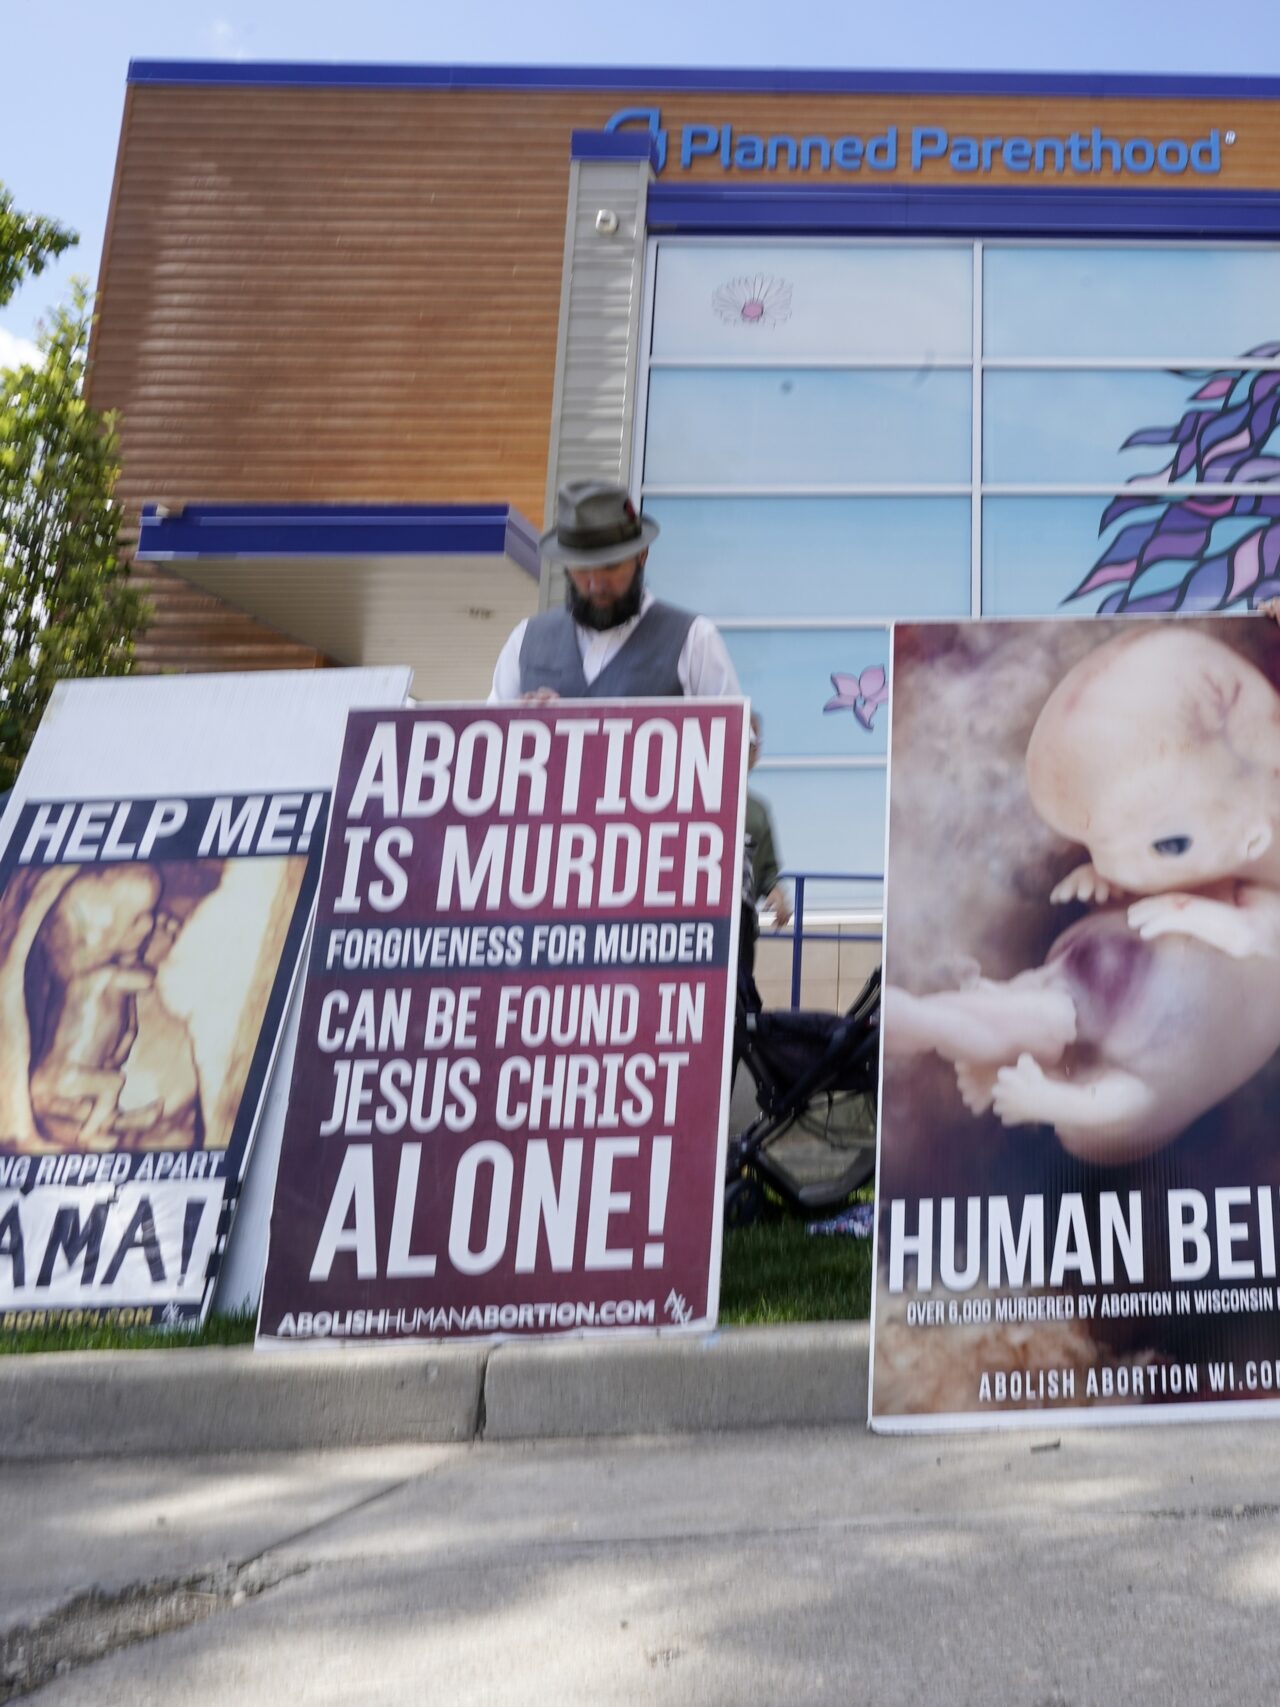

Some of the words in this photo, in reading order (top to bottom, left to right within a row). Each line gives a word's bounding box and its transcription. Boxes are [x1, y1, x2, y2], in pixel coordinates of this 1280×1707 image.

[680, 122, 898, 170] Planned
[911, 126, 1222, 174] Parenthood
[347, 716, 727, 820] ABORTION
[18, 799, 189, 864] HELP
[199, 793, 324, 856] ME!
[332, 827, 414, 915] IS
[436, 821, 723, 912] MURDER
[326, 925, 524, 970] FORGIVENESS
[530, 924, 586, 965] FOR
[592, 922, 715, 961] MURDER
[317, 988, 411, 1053] CAN
[424, 987, 486, 1050] BE
[494, 984, 639, 1047] FOUND
[655, 982, 706, 1044] IN
[319, 1057, 481, 1138] JESUS
[498, 1052, 690, 1130] CHRIST
[36, 1153, 132, 1187] RIPPED
[135, 1151, 225, 1181] APART
[309, 1136, 674, 1284] ALONE!
[888, 1190, 1145, 1293] HUMAN
[277, 1299, 656, 1337] ABOLISHHUMANABORTION.COM
[906, 1302, 945, 1327] OVER
[994, 1295, 1074, 1323] MURDERED
[1078, 1294, 1098, 1320] BY
[1100, 1290, 1172, 1319] ABORTION
[1176, 1290, 1191, 1315] IN
[1194, 1287, 1274, 1315] WISCONSIN
[978, 1369, 1076, 1402] ABOLISH
[1086, 1363, 1199, 1398] ABORTION
